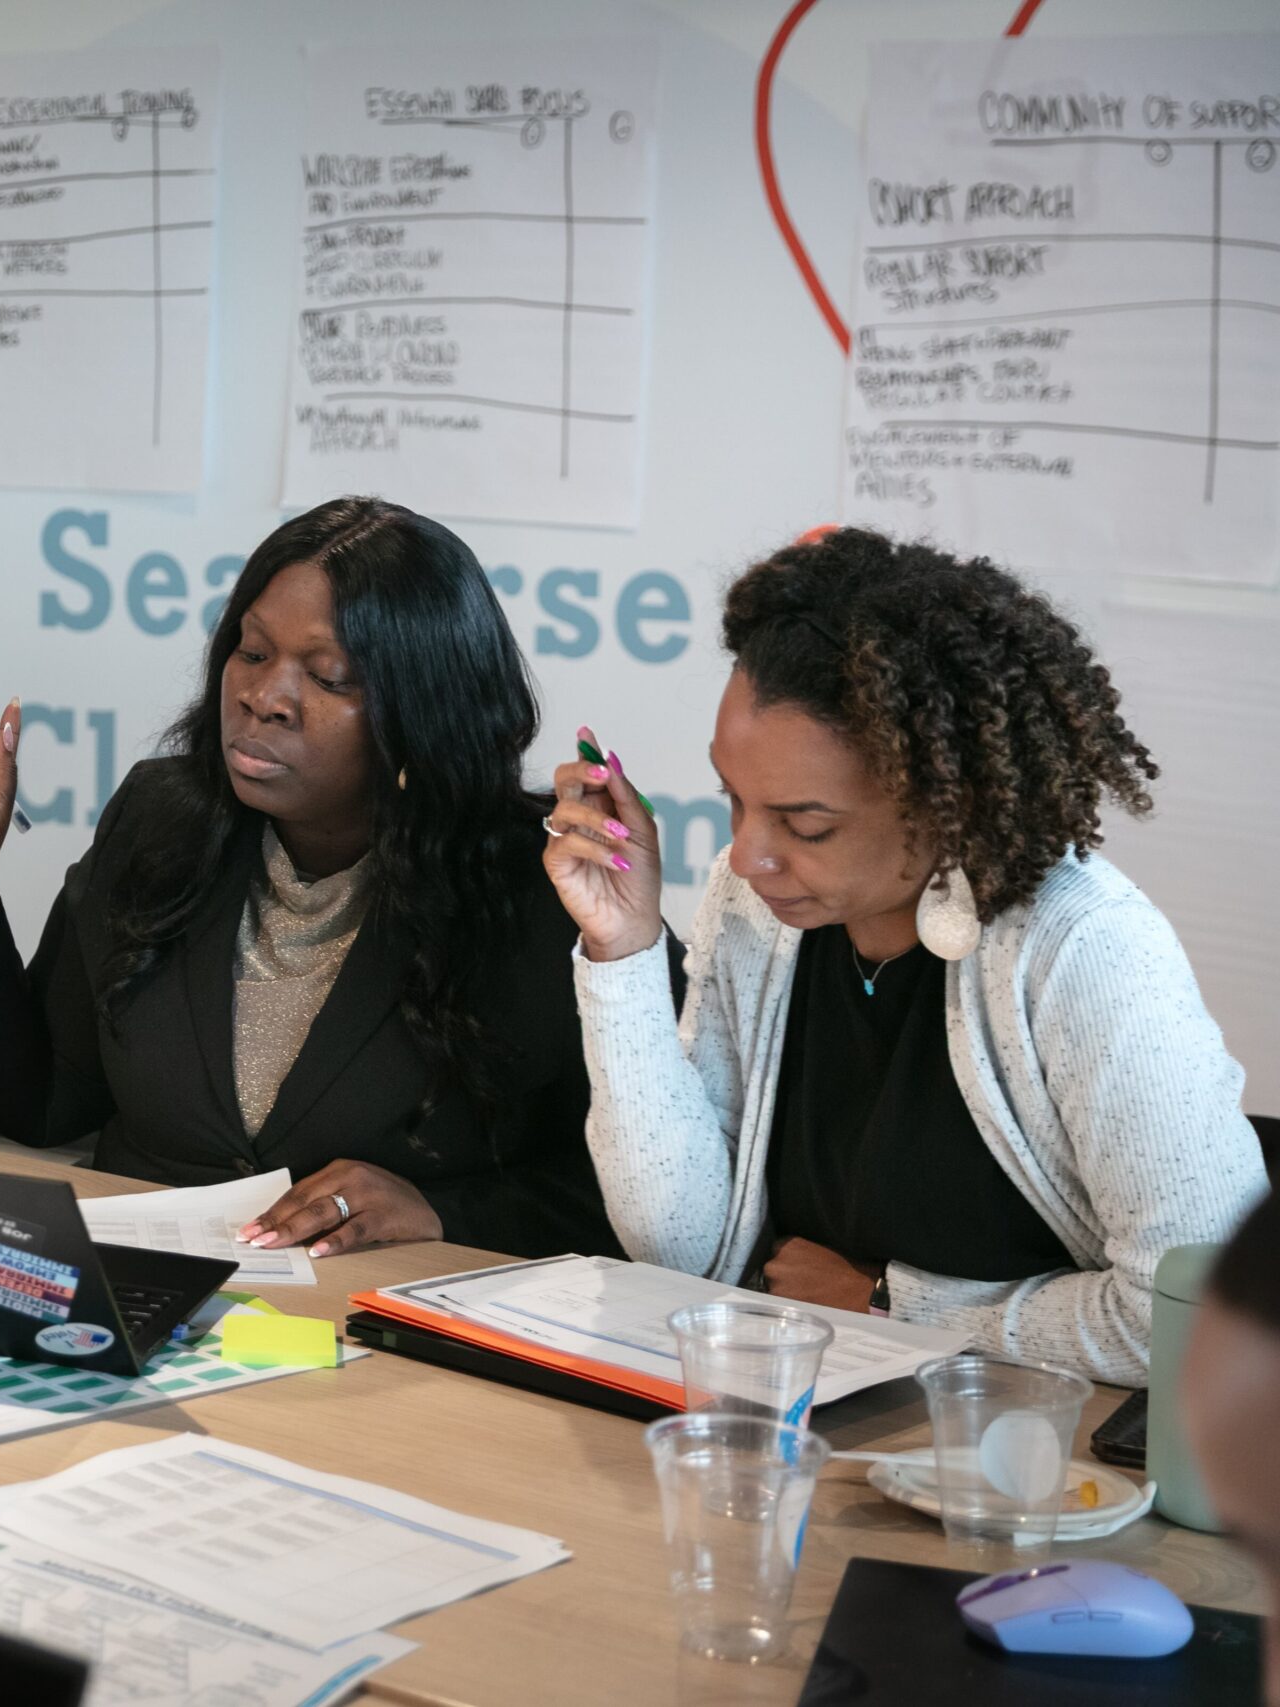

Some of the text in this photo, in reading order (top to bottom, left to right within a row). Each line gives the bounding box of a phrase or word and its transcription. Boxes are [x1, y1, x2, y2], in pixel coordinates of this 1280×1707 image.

[978, 89, 1127, 134] COMMUNITY
[1142, 94, 1183, 130] OF
[868, 177, 1076, 228] COHORT APPROACH
[961, 243, 1052, 280] SUPPORT
